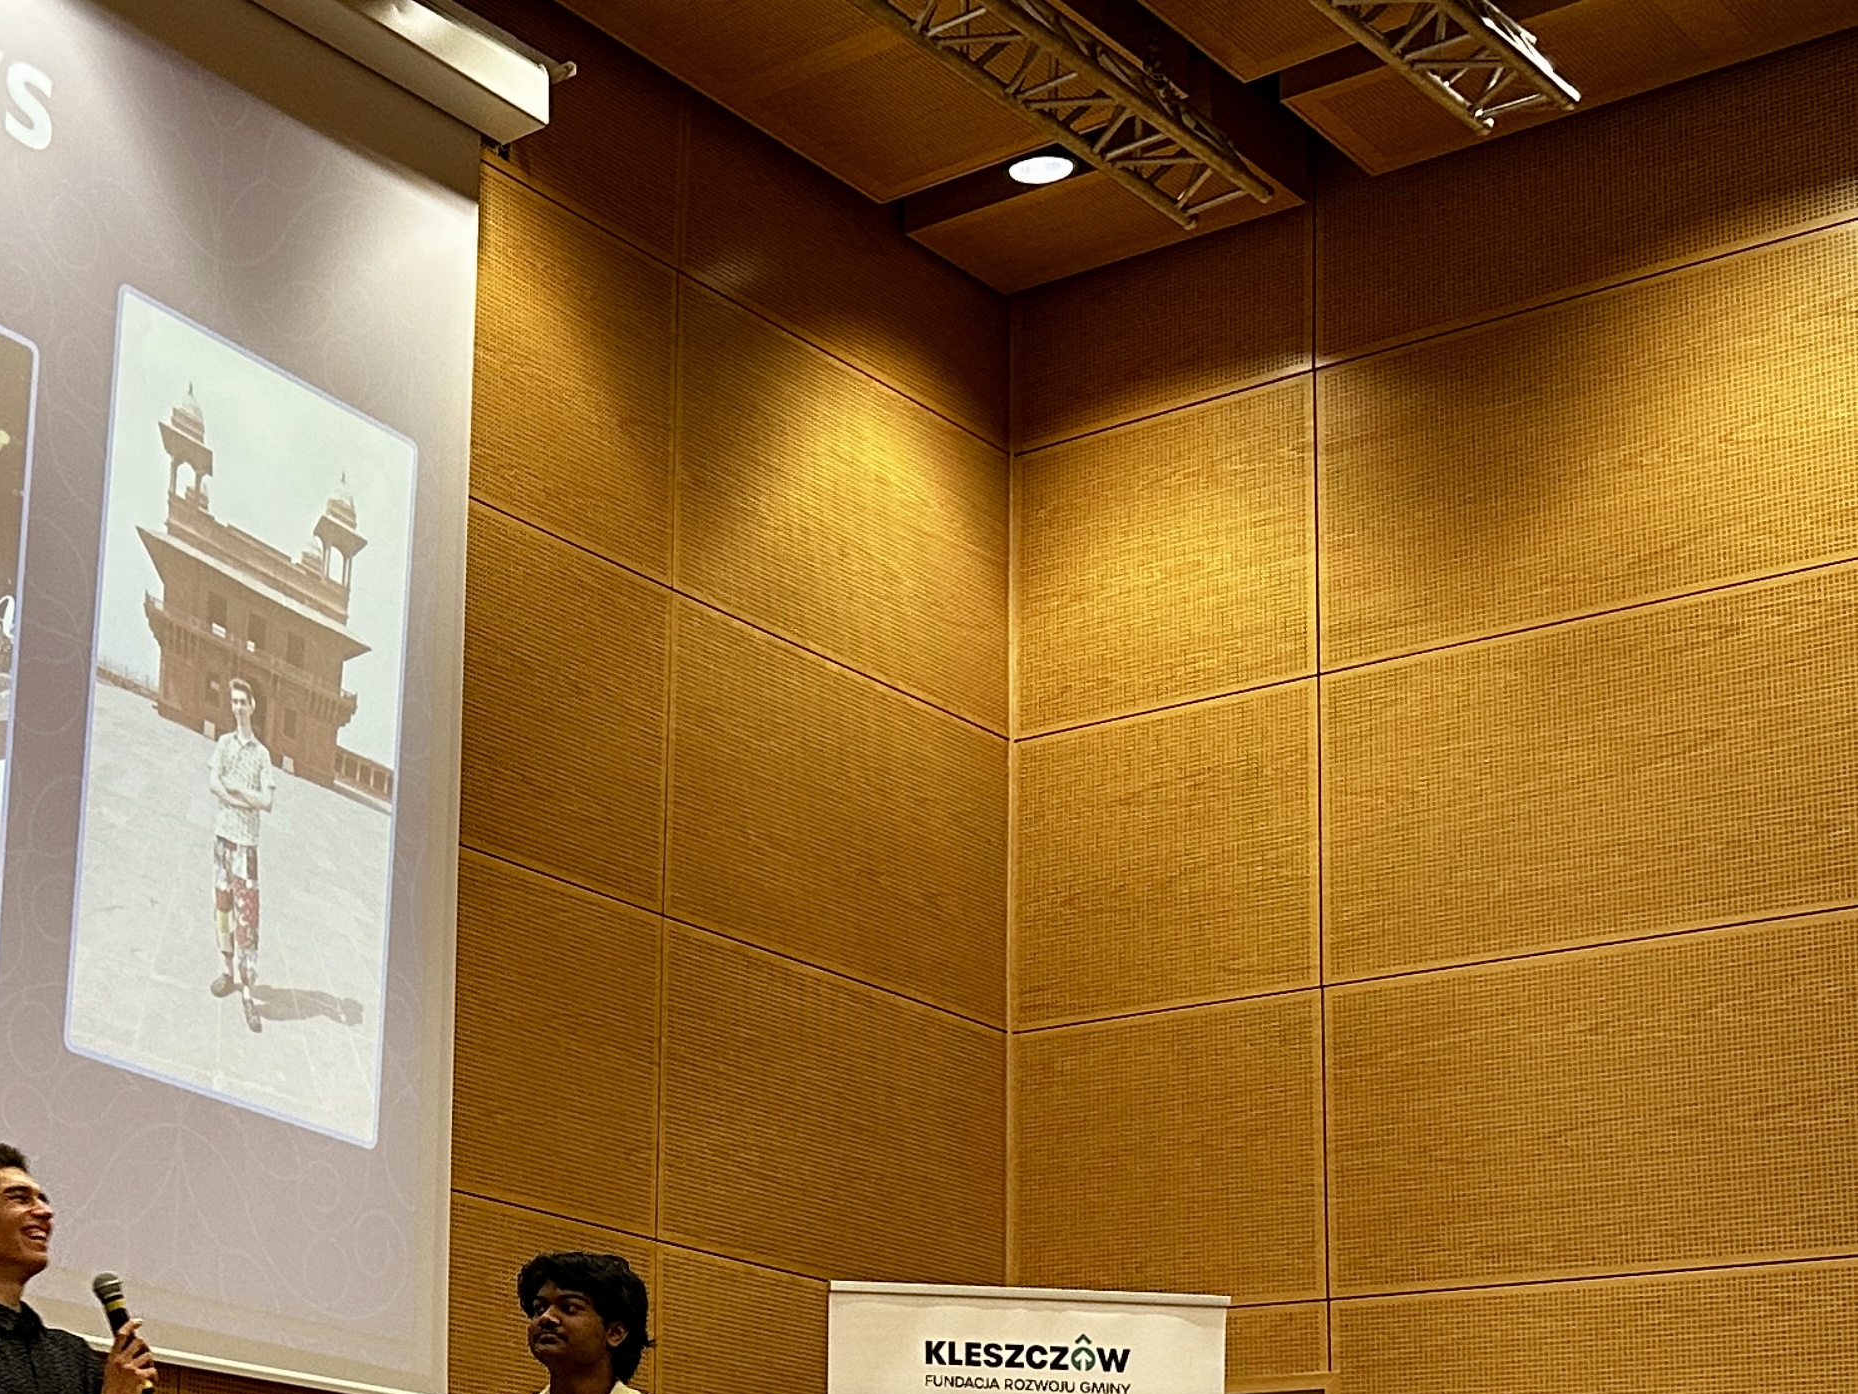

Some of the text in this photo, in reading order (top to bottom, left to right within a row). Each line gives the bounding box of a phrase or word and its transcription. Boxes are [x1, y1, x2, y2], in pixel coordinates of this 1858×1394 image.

[925, 1375, 1131, 1394] FUNDACJA ROZWOJU GMINY
